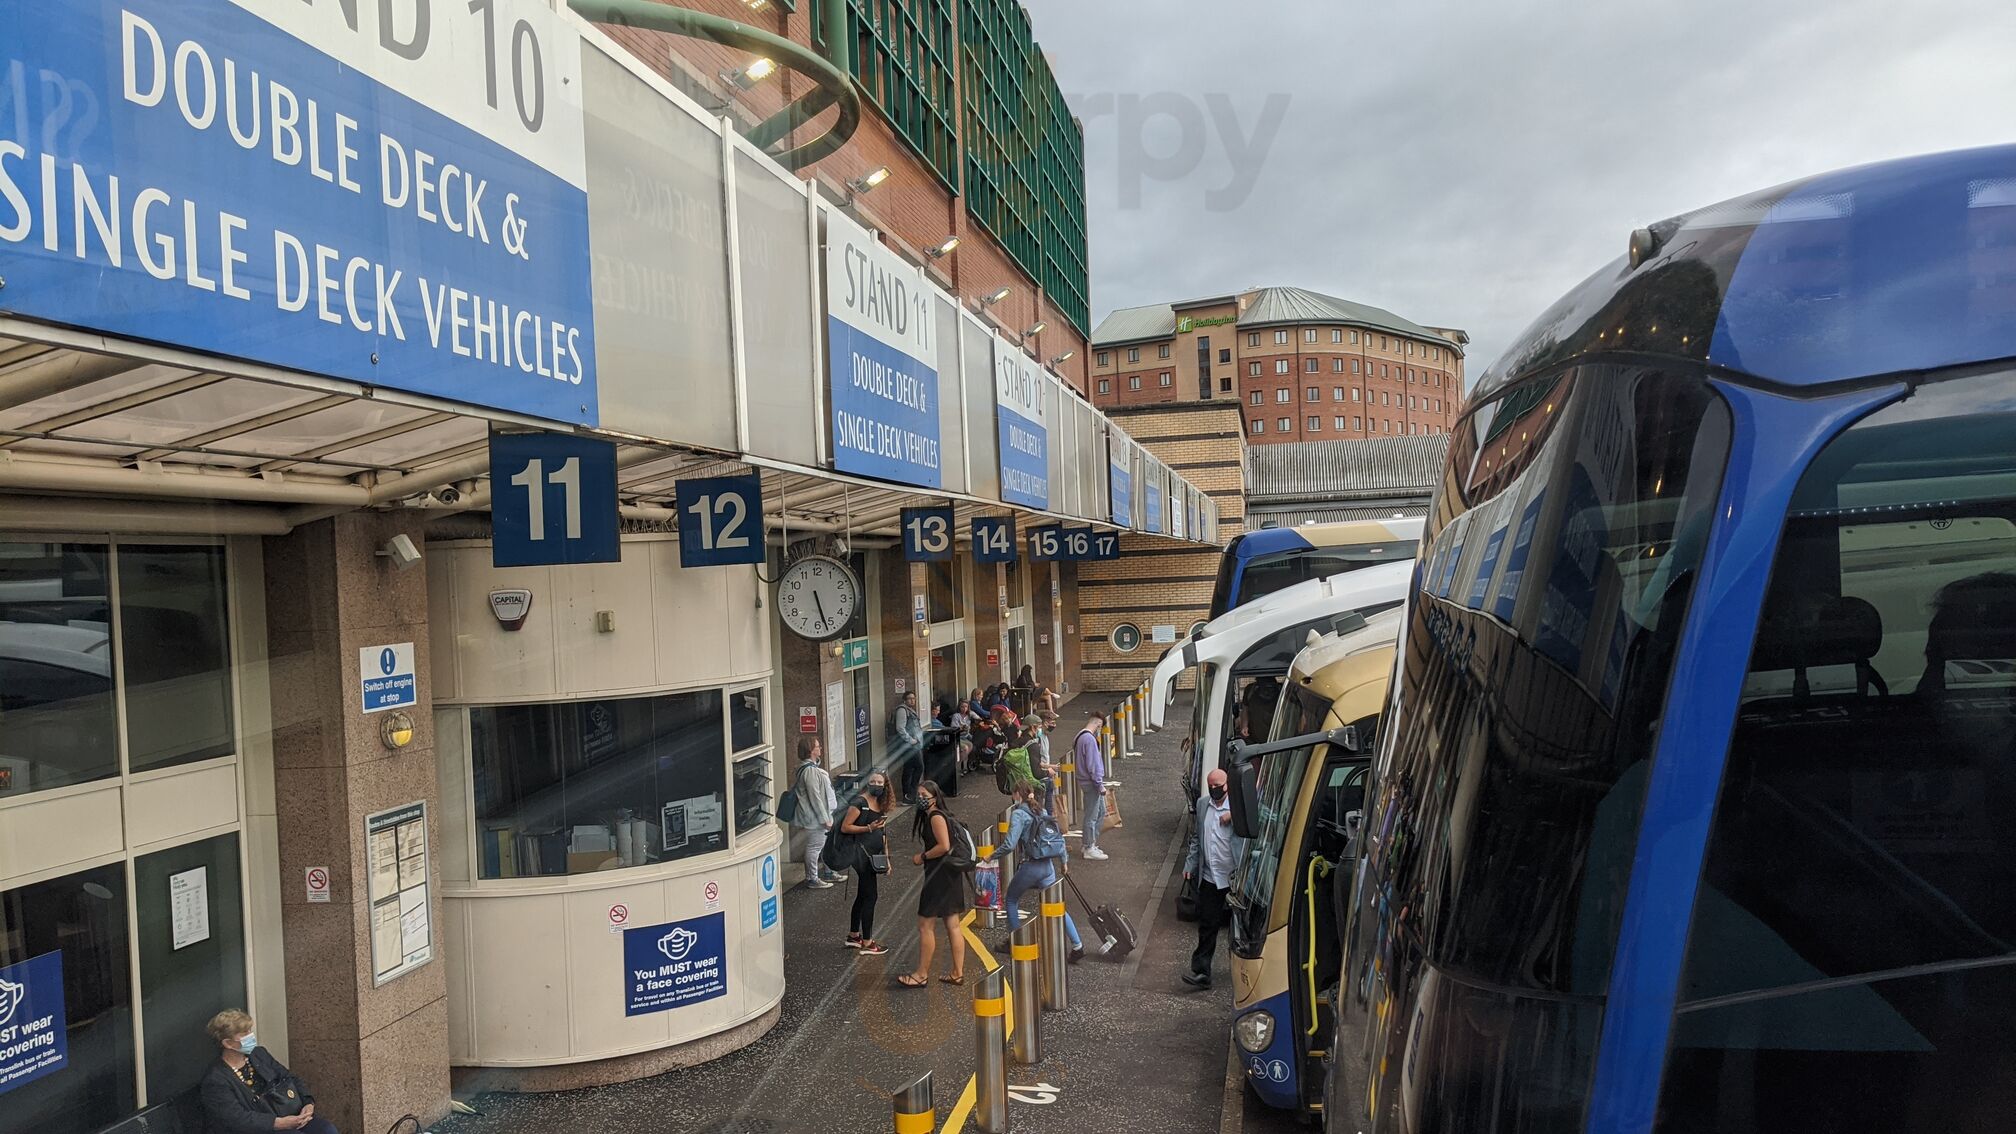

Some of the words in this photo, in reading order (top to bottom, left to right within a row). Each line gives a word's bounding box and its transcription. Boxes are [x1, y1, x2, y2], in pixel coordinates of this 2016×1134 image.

[121, 9, 361, 195] DOUBLE
[379, 132, 490, 245] DECK
[502, 192, 530, 260] &
[0, 140, 251, 301] SINGLE
[274, 229, 406, 341] DECK
[418, 277, 583, 386] VEHICLES
[845, 242, 907, 335] STAND
[913, 292, 929, 351] 11
[853, 351, 894, 401] DOUBLE
[896, 371, 919, 410] DECK
[920, 383, 926, 414] &
[1002, 355, 1031, 409] STAND
[1034, 379, 1043, 416] 12
[838, 409, 875, 454] SINGLE
[877, 422, 902, 460] DECK
[903, 430, 938, 469] VEHICLES
[1009, 424, 1027, 454] DOUBLE
[511, 457, 581, 540] 11
[688, 491, 749, 550] 12
[907, 515, 949, 553] 13
[976, 524, 1010, 555] 14
[1030, 530, 1059, 557] 15
[1064, 532, 1089, 555] 16
[1095, 536, 1115, 555] 17
[801, 571, 808, 580] 11
[813, 567, 822, 576] 12
[791, 581, 801, 590] 10
[837, 580, 844, 590] 2
[788, 594, 794, 603] 9
[840, 594, 847, 603] 3
[791, 608, 798, 616] 8
[802, 618, 808, 626] 7
[828, 617, 834, 626] 5
[837, 608, 844, 616] 4
[814, 620, 821, 630] 6
[365, 682, 384, 692] Switch
[385, 680, 393, 689] off
[394, 678, 412, 688] engine
[380, 695, 386, 703] at
[387, 693, 399, 703] stop
[634, 969, 656, 980] You
[660, 961, 692, 977] MUST
[694, 956, 718, 969] wear
[636, 984, 643, 992] a
[647, 979, 672, 990] face
[675, 967, 718, 985] covering
[22, 1015, 53, 1035] wear
[0, 1031, 54, 1061] covering
[25, 1056, 36, 1065] bus
[42, 1048, 56, 1057] train
[8, 1063, 37, 1081] Passenger
[38, 1054, 62, 1068] Facilities
